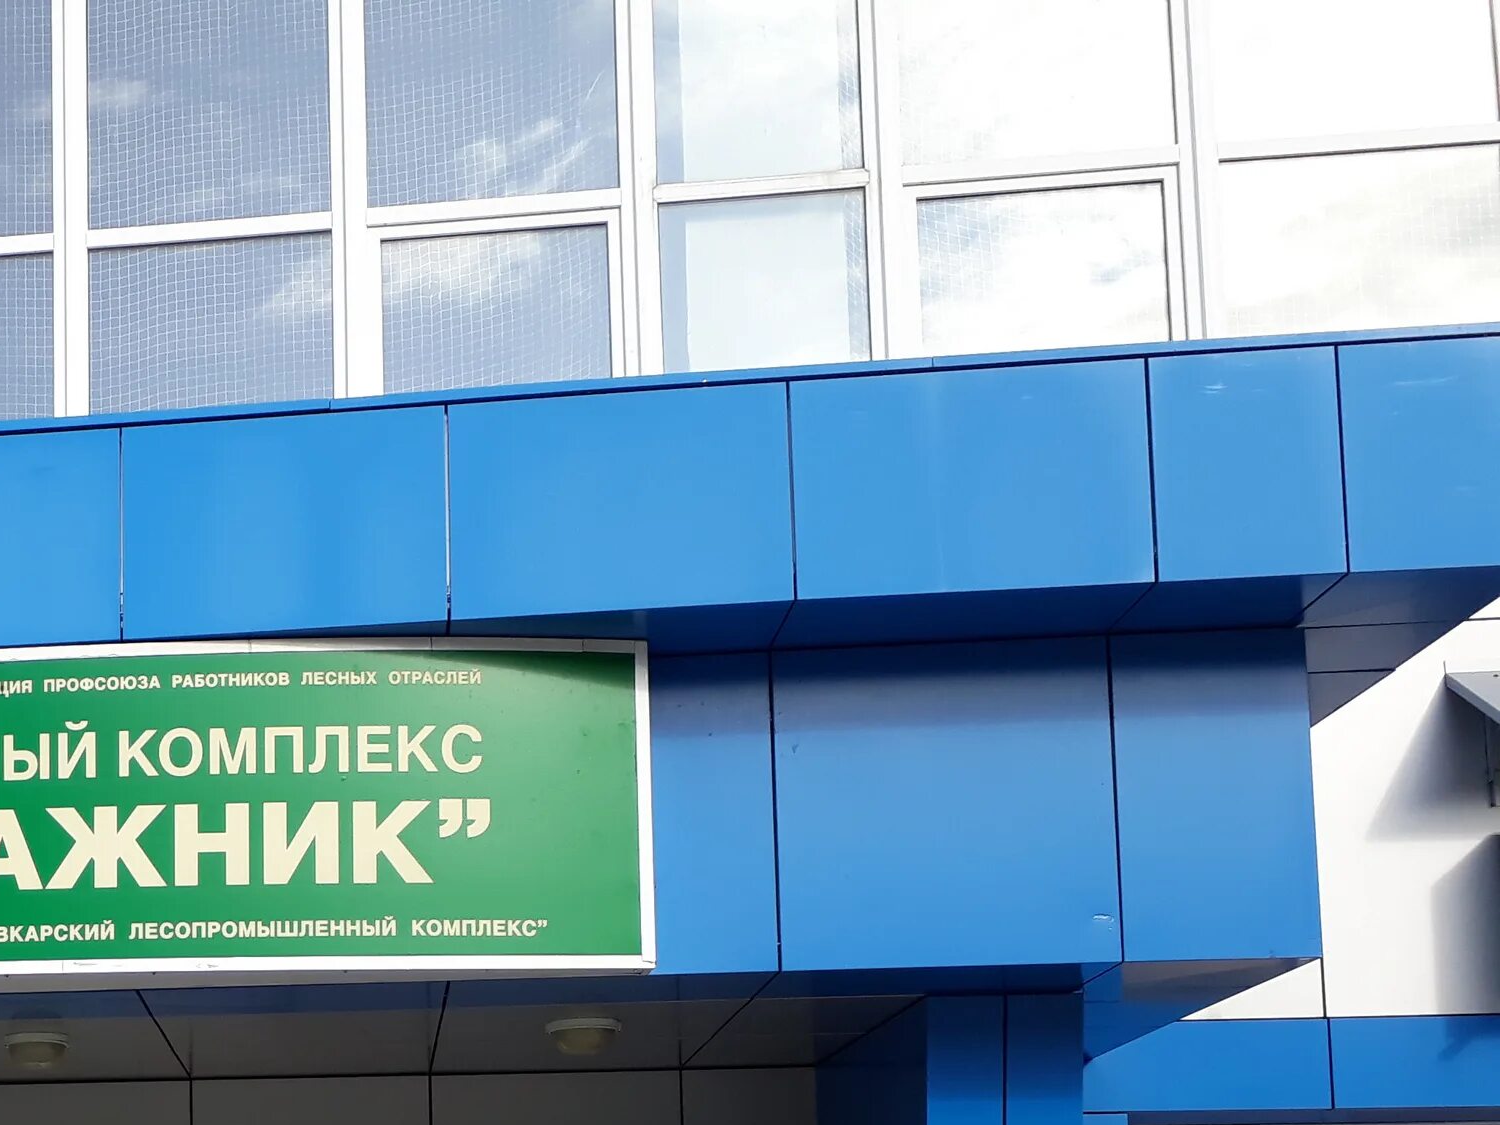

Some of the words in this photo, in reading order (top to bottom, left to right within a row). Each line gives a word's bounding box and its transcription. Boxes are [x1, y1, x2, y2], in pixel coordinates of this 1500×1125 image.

[43, 675, 161, 693] ПРОФСОЮЗА
[171, 671, 291, 689] РАБОТНИКОВ
[300, 670, 380, 686] ЛЕСНЫХ
[388, 668, 483, 686] ОТРАСЛЕЙ
[118, 722, 485, 778] КОМПЛЕКС
[128, 915, 397, 940] ЛЕСОПРОМЫШЛЕННЫЙ
